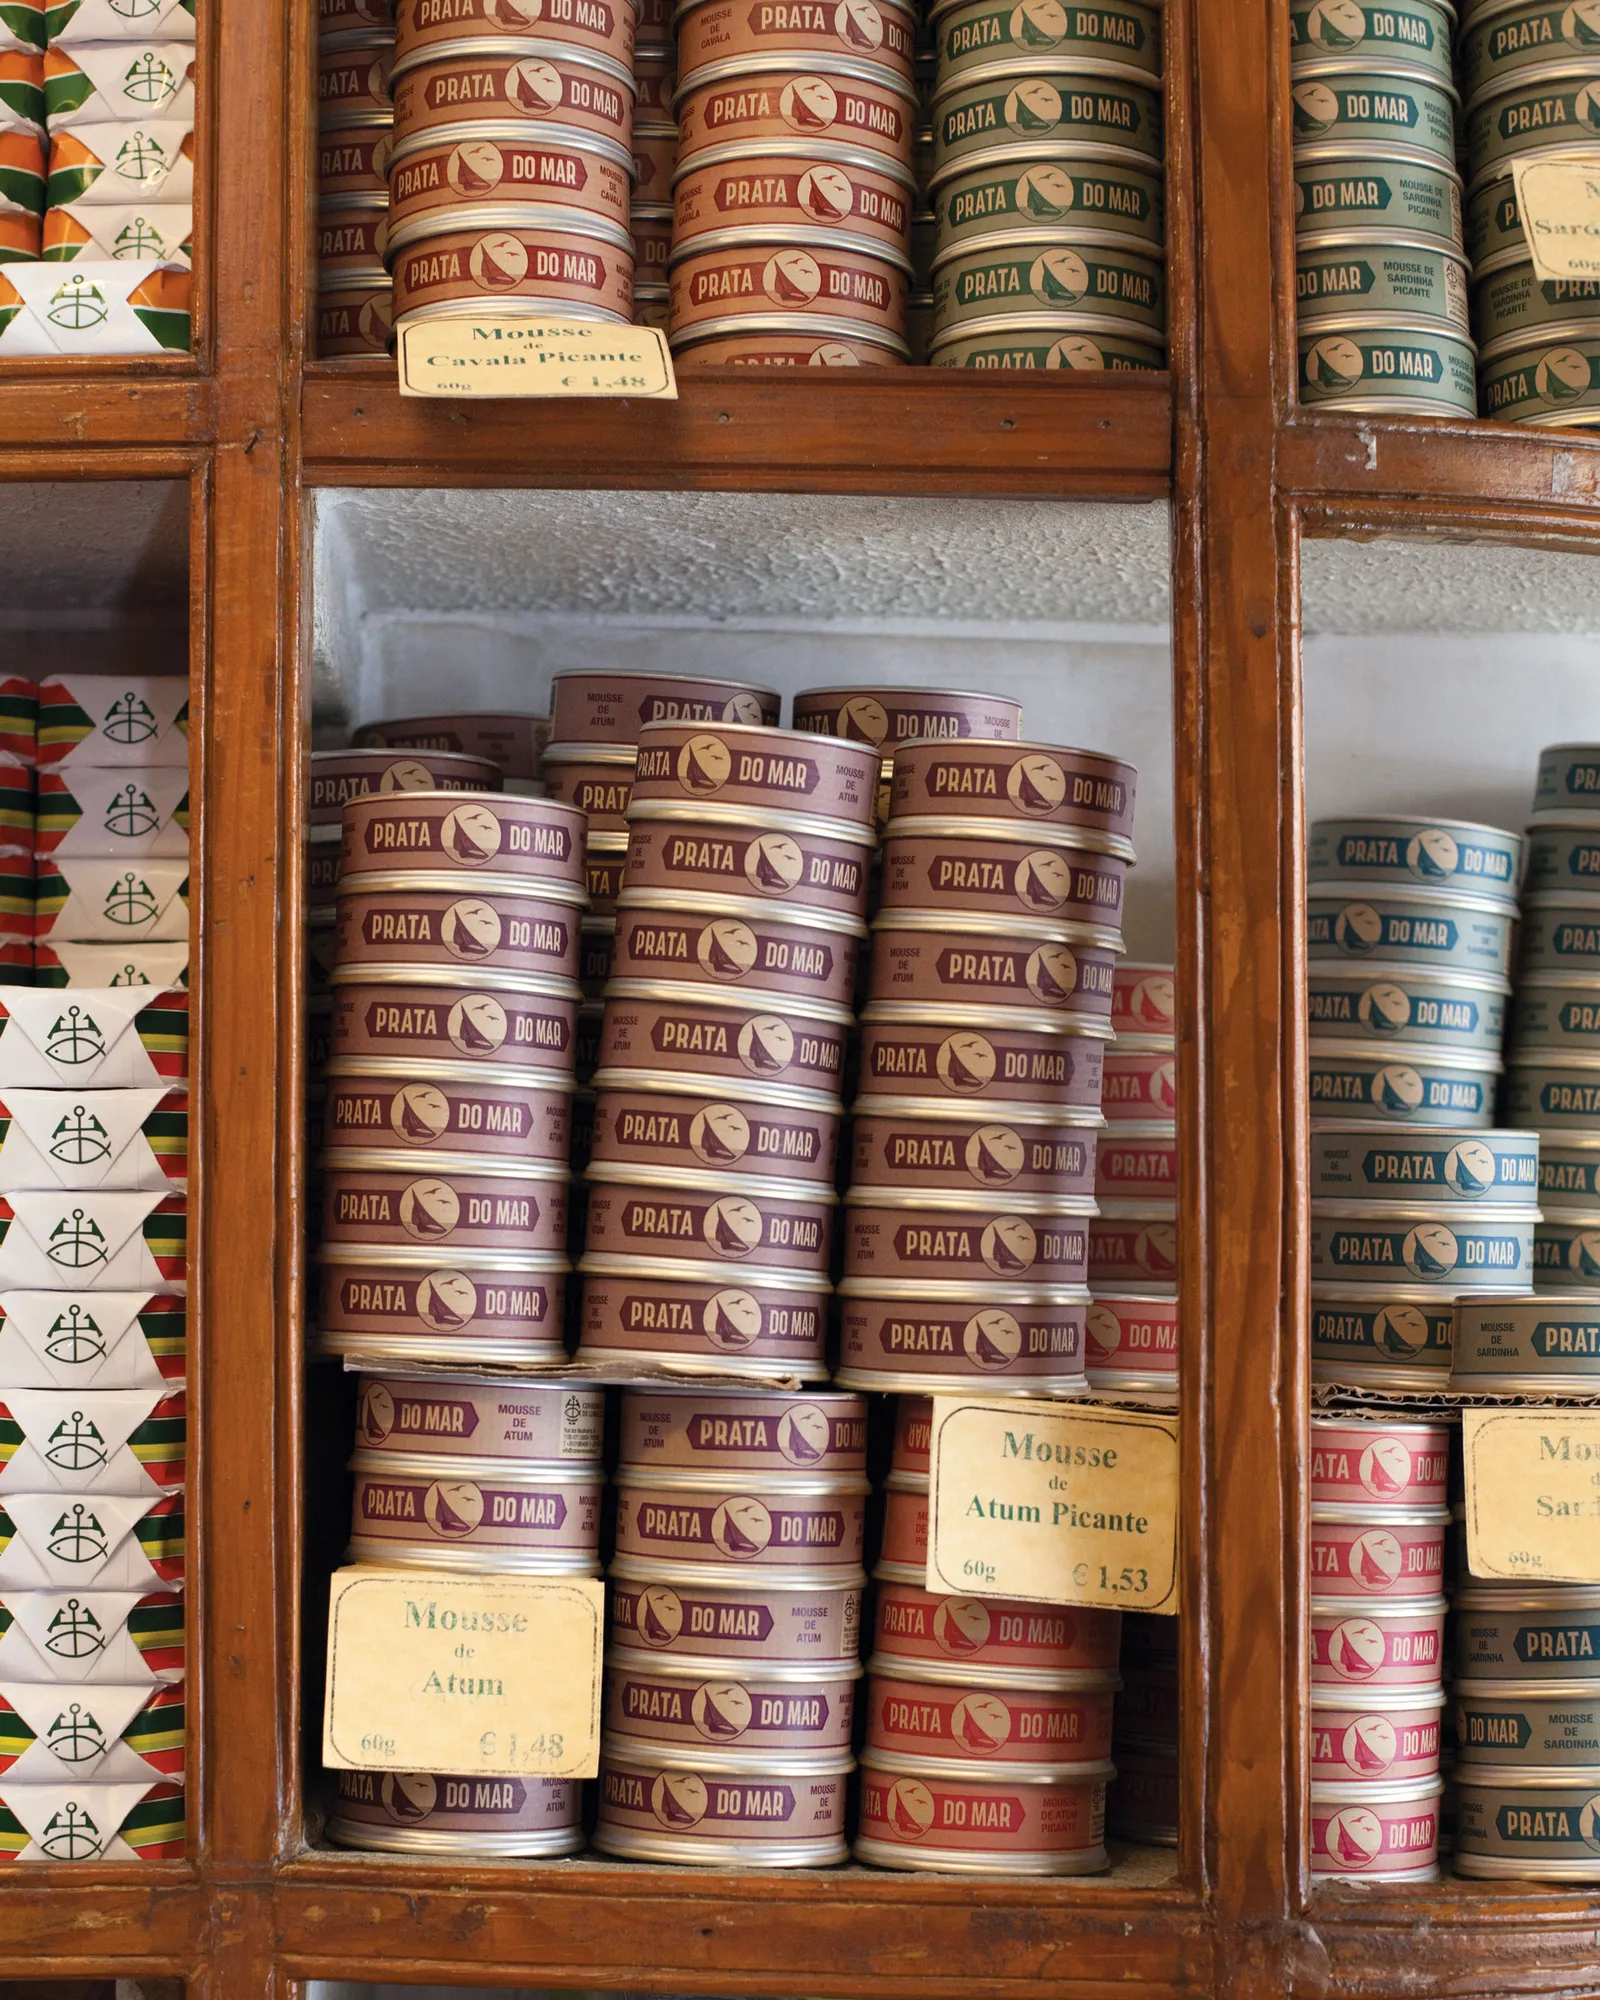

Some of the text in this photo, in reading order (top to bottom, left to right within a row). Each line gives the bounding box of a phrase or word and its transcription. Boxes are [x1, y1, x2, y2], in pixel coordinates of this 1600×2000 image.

[700, 8, 732, 27] MOUSSE
[710, 24, 721, 34] DE
[761, 6, 902, 49] PRATA DO
[953, 13, 1135, 54] PRATA DO MAR
[1374, 17, 1395, 38] DO
[1399, 21, 1427, 45] MAR
[701, 32, 731, 50] CAVALA
[1498, 22, 1551, 53] PRATA
[435, 74, 618, 119] PRATA DO MAR
[713, 93, 896, 137] PRATA DO MAR
[399, 156, 576, 198] PRATA DO MAR
[600, 165, 623, 185] MOUSSE
[609, 181, 617, 193] DE
[1313, 181, 1378, 207] DO MAR
[1400, 179, 1444, 198] MOUSSE DE
[601, 189, 622, 208] CAVALA
[726, 179, 902, 229] PRATA DO MAR
[1402, 192, 1442, 209] SARDINHA
[1408, 204, 1440, 219] PICANTE
[1383, 261, 1435, 276] MOUSSE DE
[964, 267, 1150, 302] PRATA DO MAR
[1297, 267, 1361, 296] DO MAR
[1387, 274, 1434, 288] SARDINHA
[1392, 286, 1431, 299] PICANTE
[472, 327, 592, 340] Mousse
[427, 353, 642, 366] Cavala Picante
[437, 383, 472, 391] 60g
[592, 376, 646, 388] 1,48
[1487, 375, 1528, 409] PRATA
[588, 693, 623, 703] MOUSSE
[598, 705, 609, 715] DE
[590, 716, 615, 726] ATUM
[897, 714, 959, 738] DO MAR
[985, 716, 1010, 728] MOUSSE
[994, 729, 1003, 738] DE
[637, 752, 807, 789] PRATA DO MAR
[836, 764, 865, 780] MOUSSE
[846, 780, 855, 790] DE
[838, 791, 858, 804] ATUM
[373, 822, 563, 856] PRATA DO MAR
[1345, 841, 1398, 863] PRATA
[1464, 849, 1482, 872] DO
[1484, 851, 1507, 876] MAR
[1389, 921, 1409, 942] DO
[1414, 922, 1448, 946] MAR
[890, 948, 920, 958] MOUSSE
[898, 961, 908, 970] DE
[950, 954, 1016, 982] PRATA
[1083, 964, 1096, 989] DO
[892, 973, 914, 982] ATUM
[613, 1015, 638, 1025] MOUSSE
[619, 1027, 626, 1038] DE
[613, 1040, 631, 1050] ATUM
[337, 1099, 522, 1132] PRATA DO MAR
[1112, 1154, 1170, 1178] PRATA
[1374, 1156, 1534, 1182] PRATA DO MAR
[855, 1224, 880, 1235] MOUSSE
[861, 1238, 870, 1247] DE
[906, 1230, 970, 1257] PRATA
[1043, 1234, 1061, 1259] DO
[1063, 1237, 1082, 1260] MAR
[857, 1249, 874, 1260] ATUM
[630, 1302, 815, 1336] PRATA DO MAR
[1481, 1323, 1514, 1333] MOUSSE
[1491, 1335, 1501, 1345] DE
[1477, 1347, 1519, 1357] SARDINHA
[498, 1404, 542, 1416] MOUSSE
[400, 1404, 464, 1432] DO MAR
[513, 1418, 526, 1428] DE
[640, 1412, 671, 1424] MOUSSE
[504, 1431, 533, 1441] ATUM
[649, 1426, 659, 1436] DE
[700, 1420, 850, 1447] PRATA DO
[643, 1438, 664, 1449] ATUM
[1002, 1431, 1118, 1468] Mousse
[1048, 1476, 1067, 1491] de
[368, 1488, 556, 1524] PRATA DO MAR
[965, 1495, 1148, 1534] Atum Picante
[963, 1559, 1148, 1593] 60g € 1,53
[404, 1600, 528, 1632] Mousse
[792, 1607, 828, 1619] MOUSSE
[804, 1620, 816, 1630] DE
[884, 1608, 1064, 1643] PRATA DO MAR
[1471, 1628, 1499, 1637] MOUSSE
[796, 1632, 821, 1643] ATUM
[1479, 1641, 1488, 1649] DE
[1527, 1631, 1593, 1656] PRATA
[455, 1643, 475, 1659] de
[1393, 1634, 1434, 1662] DO MAR
[1469, 1653, 1503, 1662] SARDINHA
[422, 1670, 504, 1696] Atum
[1549, 1714, 1593, 1723] MOUSSE
[1471, 1718, 1518, 1743] DO MAR
[1564, 1727, 1578, 1736] DE
[361, 1732, 564, 1765] 60g € 1,48
[1544, 1740, 1598, 1749] SARDINHA
[810, 1784, 836, 1795] MOUSSE
[819, 1798, 828, 1807] DE
[1042, 1797, 1077, 1807] MOUSSE
[813, 1810, 832, 1820] ATUM
[1041, 1809, 1077, 1820] DE ATUM
[1041, 1822, 1077, 1832] PICANTE
